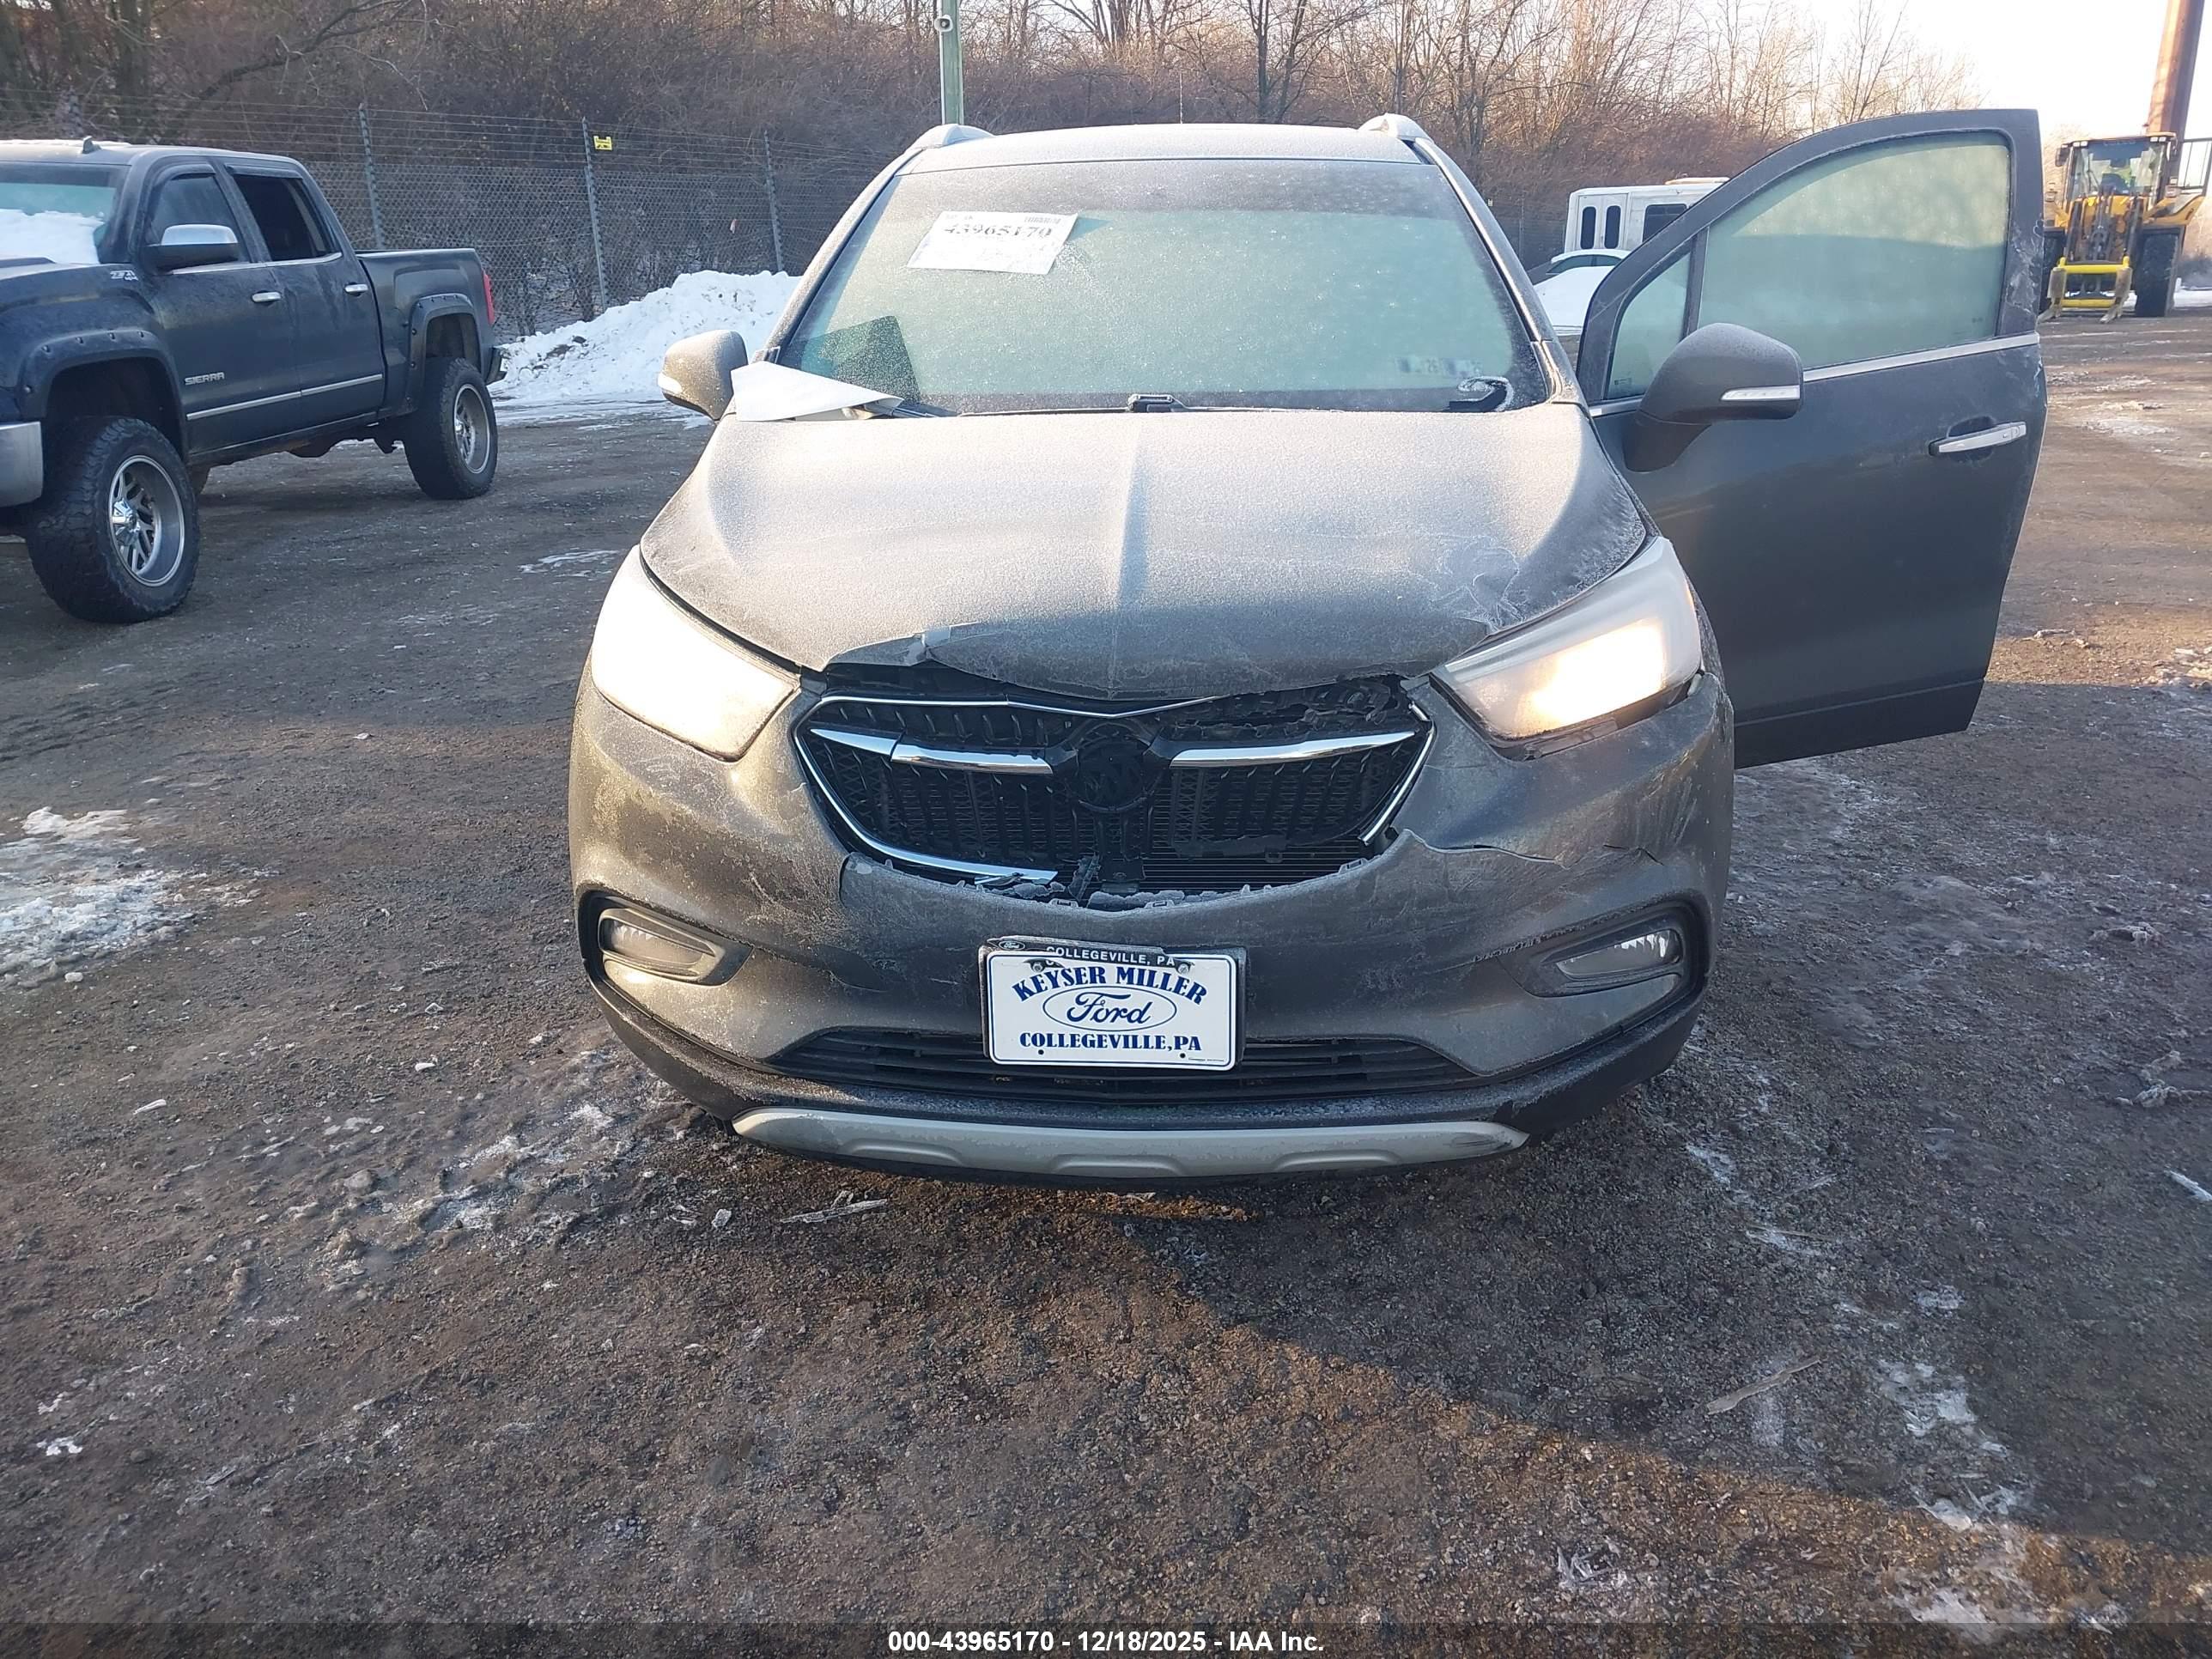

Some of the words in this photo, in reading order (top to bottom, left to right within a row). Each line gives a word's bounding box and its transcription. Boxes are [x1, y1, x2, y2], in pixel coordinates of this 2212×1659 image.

[185, 372, 225, 386] SIERRA
[1157, 955, 1176, 966] PA
[1012, 966, 1107, 1002] KEYSER
[1115, 966, 1207, 1006] MILLER
[1066, 991, 1153, 1024] Ford
